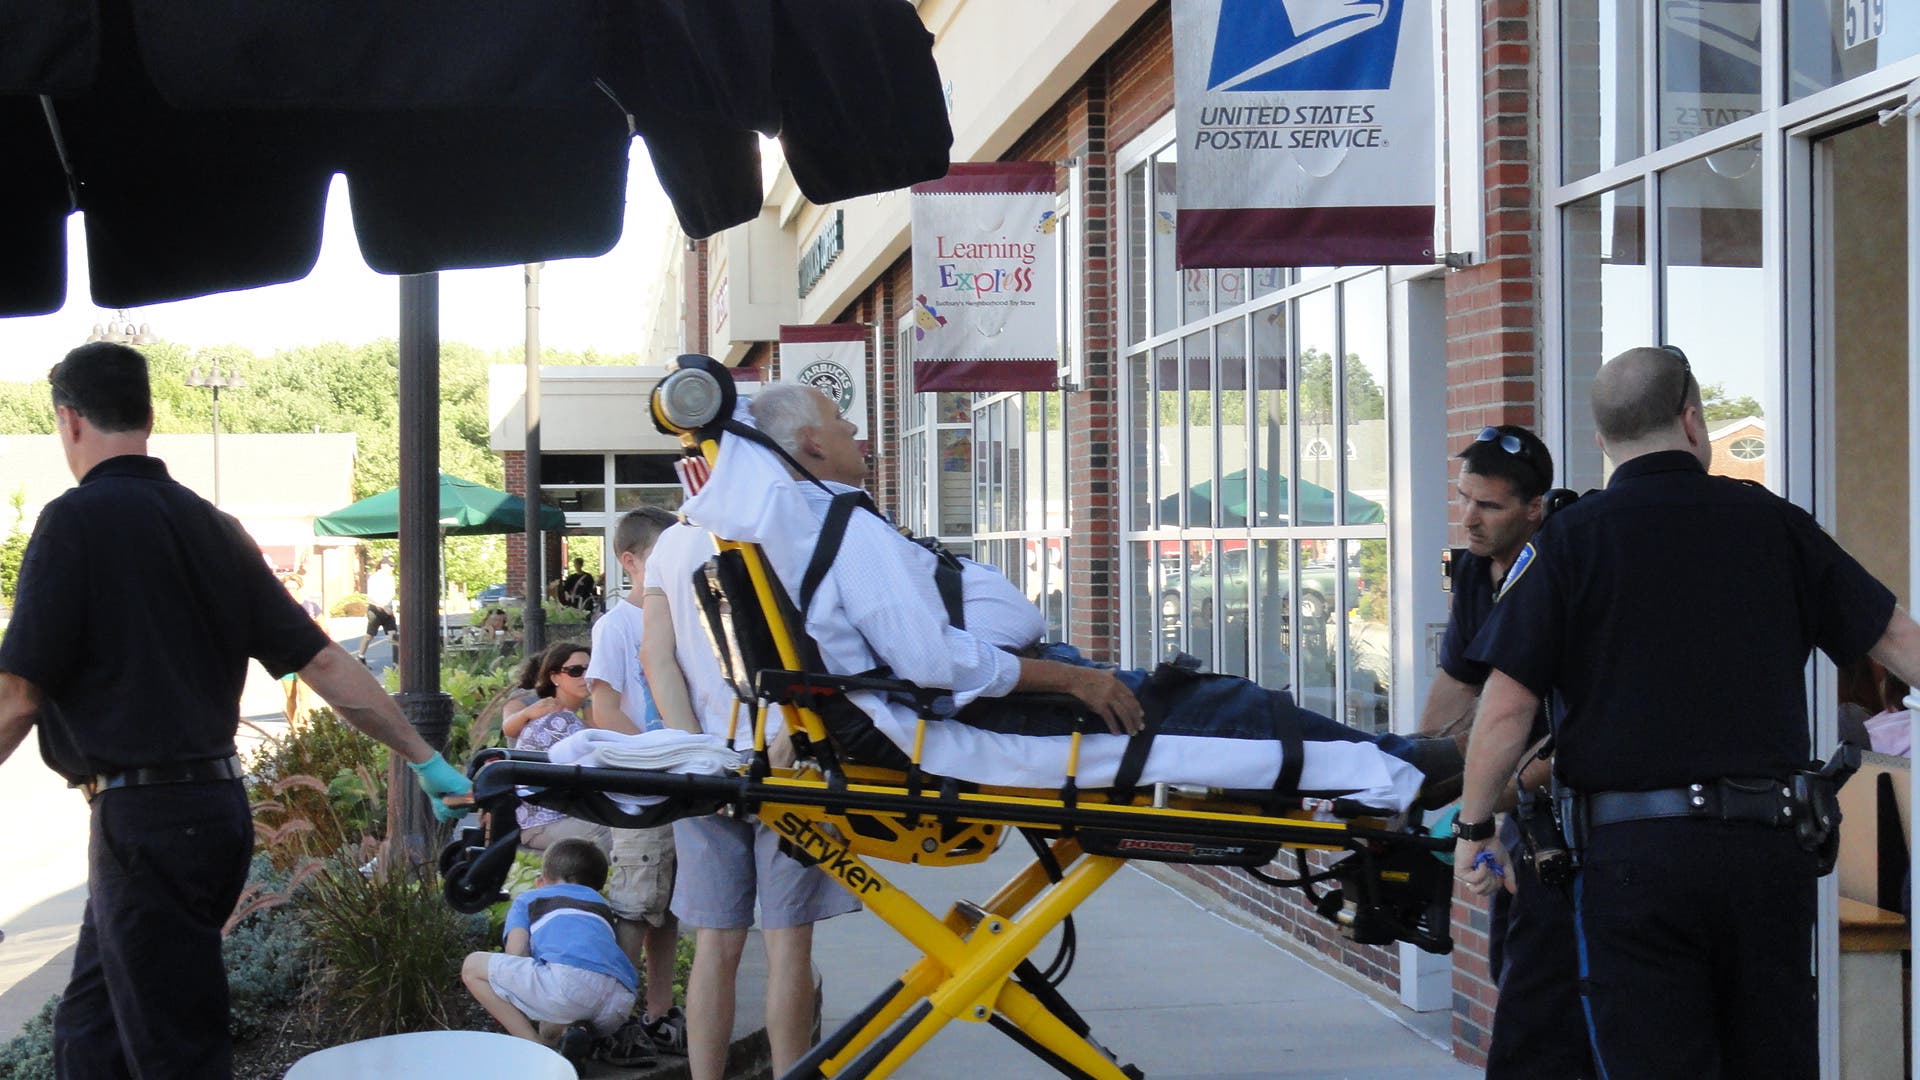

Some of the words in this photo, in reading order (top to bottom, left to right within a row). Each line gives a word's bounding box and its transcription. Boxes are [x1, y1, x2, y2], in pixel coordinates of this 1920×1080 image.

[1846, 0, 1884, 47] 519
[1201, 106, 1290, 126] UNITED
[1294, 105, 1375, 125] STATES
[1195, 131, 1283, 150] POSTAL
[1288, 129, 1382, 149] SERVICE
[936, 236, 1036, 264] Learning
[939, 264, 1032, 299] Express
[800, 363, 852, 389] TARBUCKS
[773, 812, 882, 894] stryker
